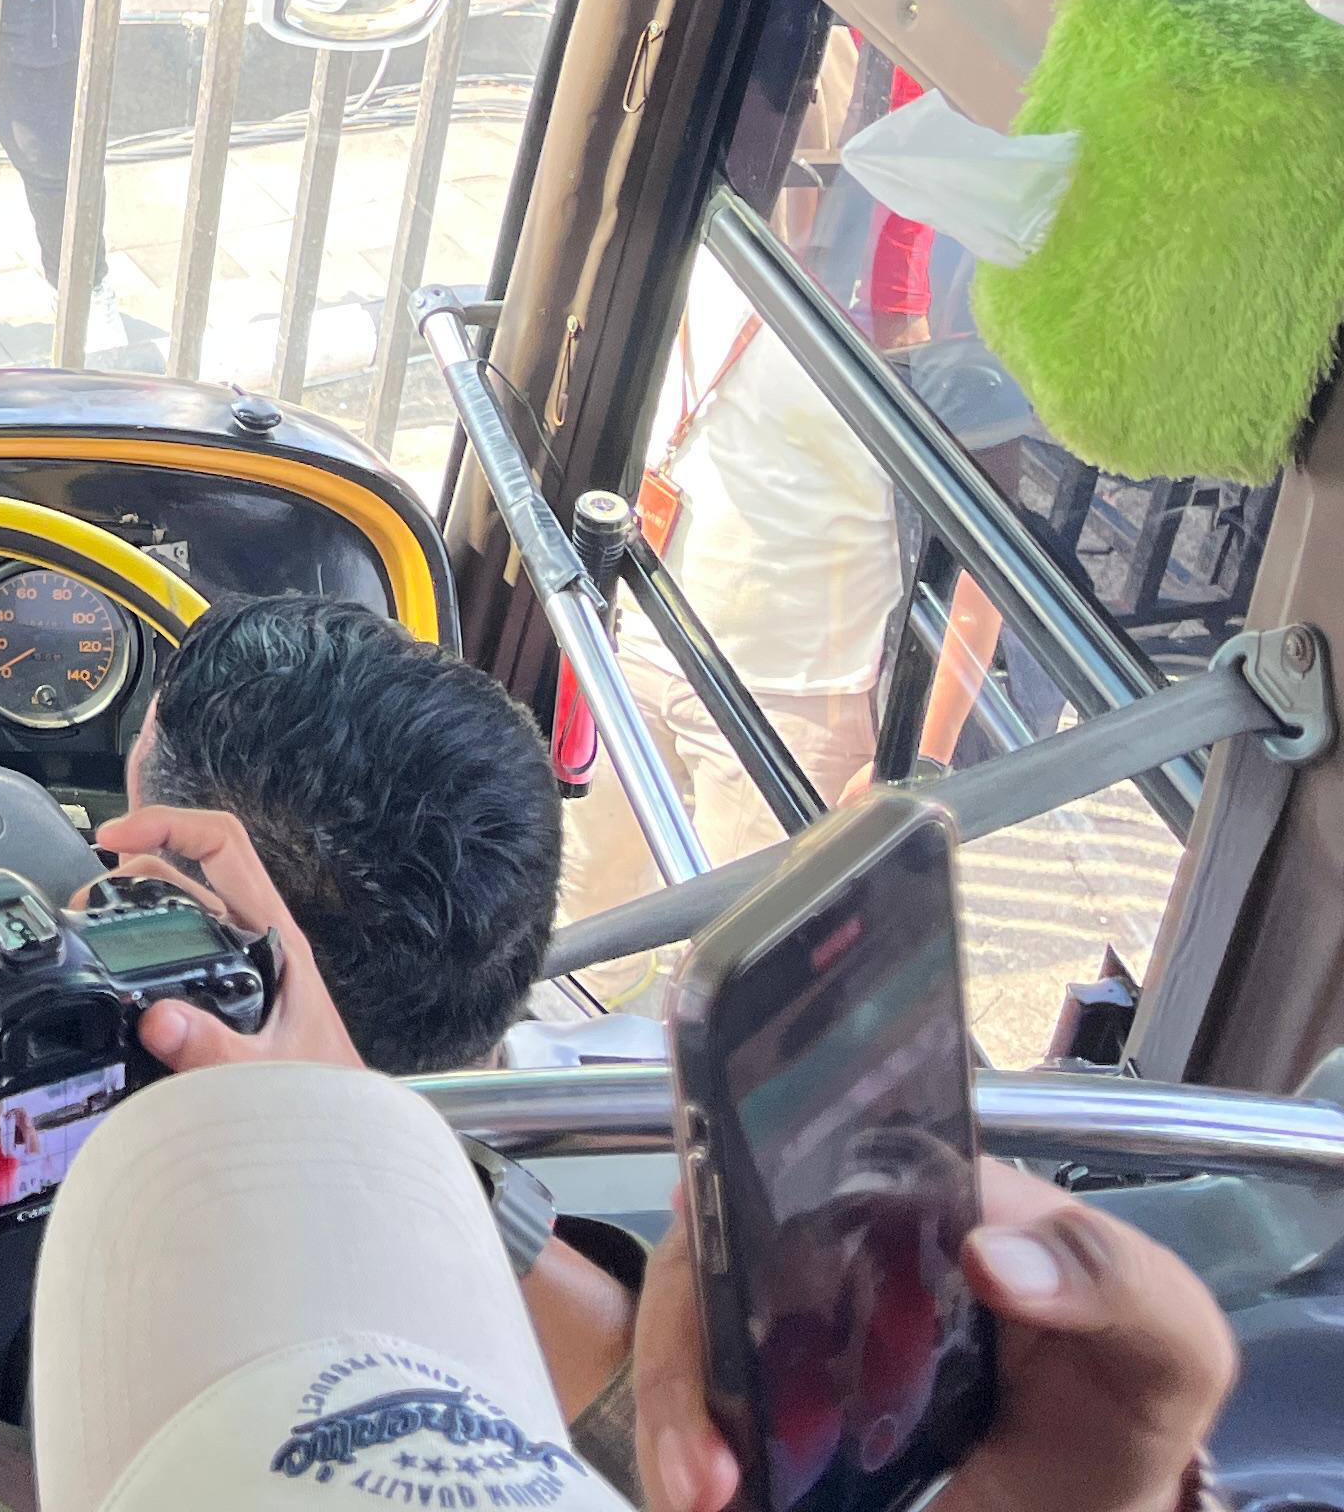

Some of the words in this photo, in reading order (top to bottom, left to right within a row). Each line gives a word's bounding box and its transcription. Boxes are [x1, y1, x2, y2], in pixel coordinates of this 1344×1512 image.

[16, 588, 38, 600] 60
[52, 589, 73, 601] 80
[72, 612, 96, 624] 100
[78, 640, 102, 653] 120
[67, 669, 91, 681] 140
[349, 1468, 477, 1509] QUALITY
